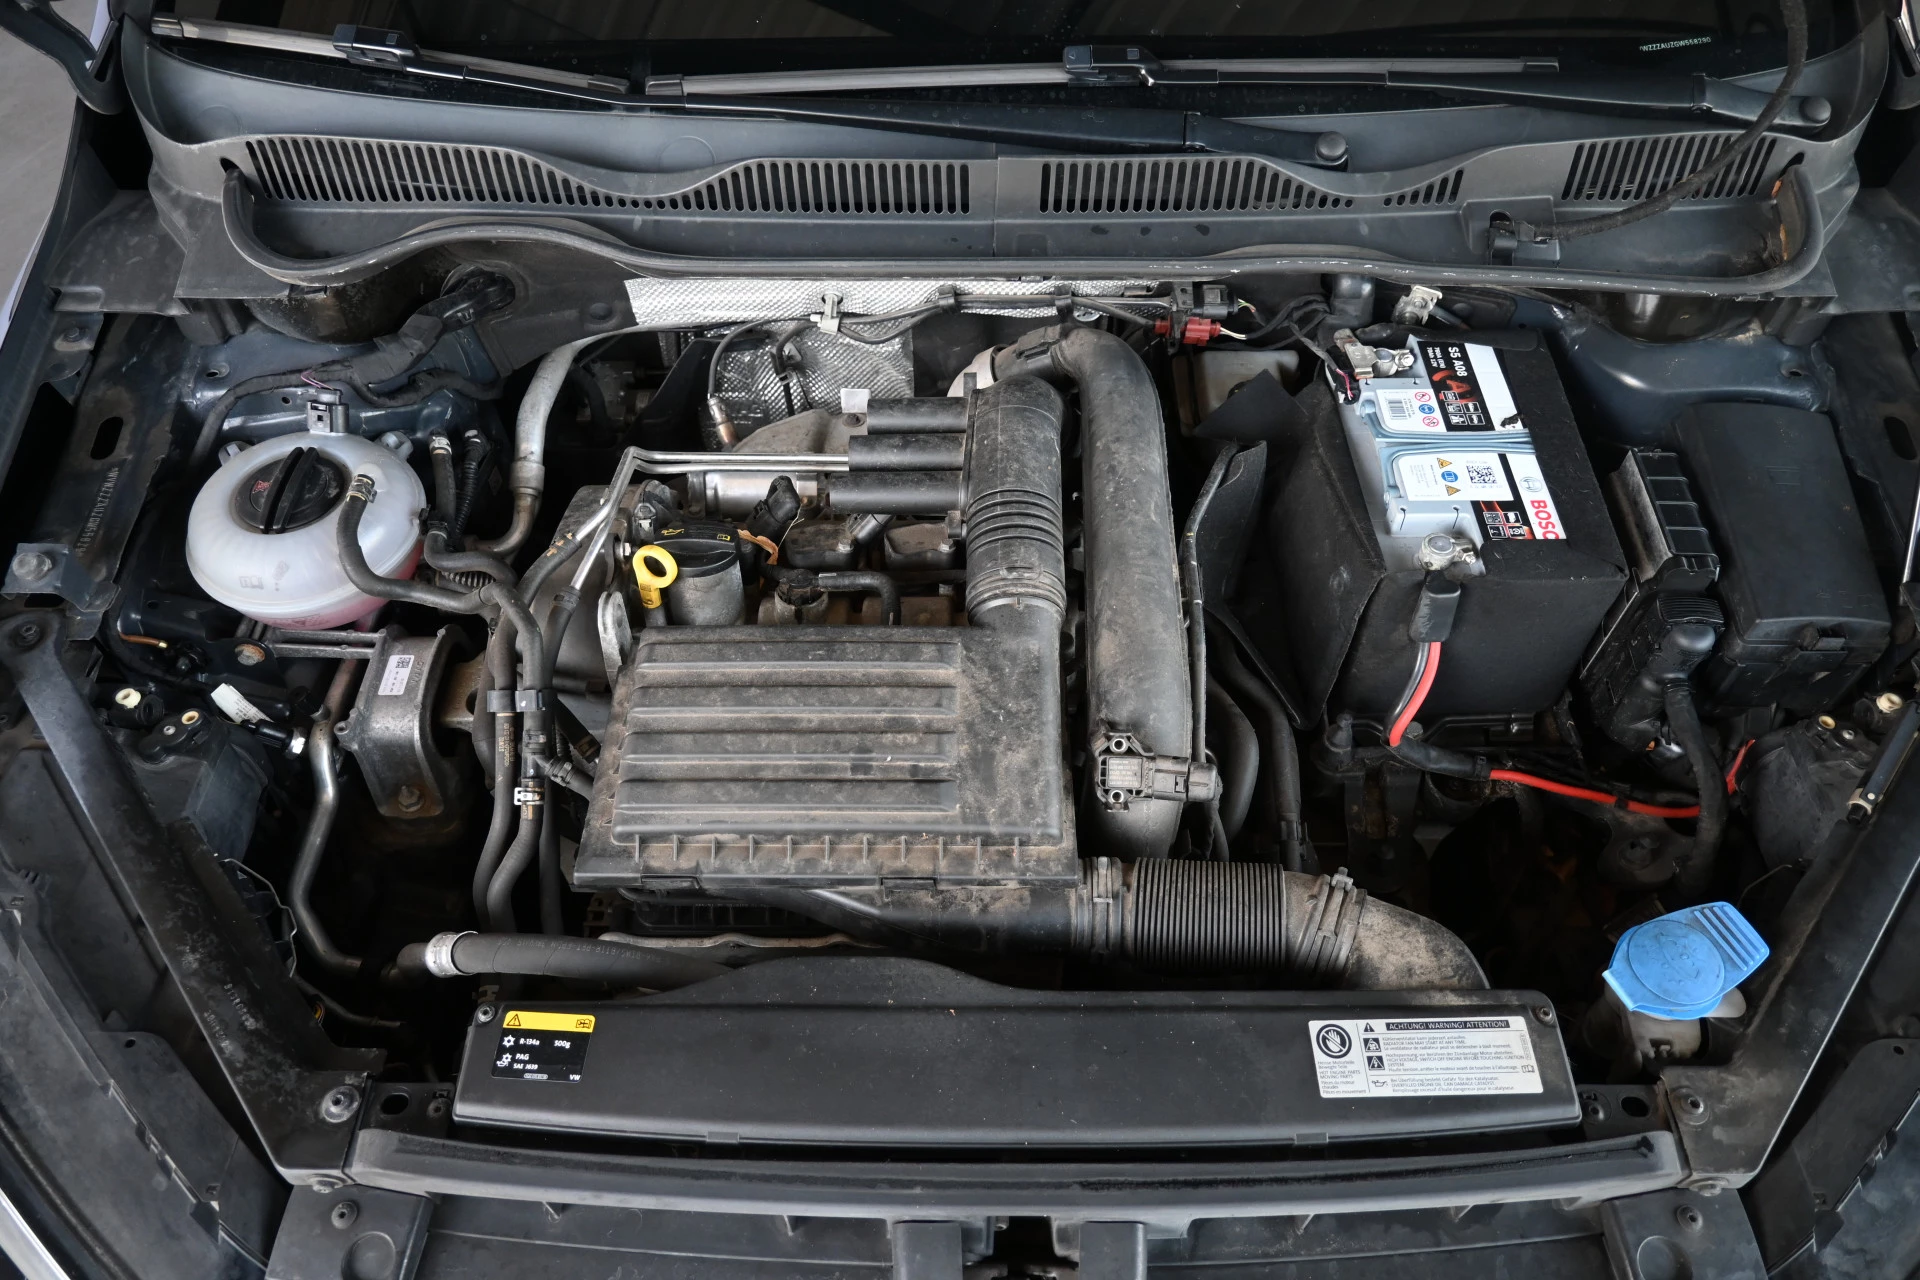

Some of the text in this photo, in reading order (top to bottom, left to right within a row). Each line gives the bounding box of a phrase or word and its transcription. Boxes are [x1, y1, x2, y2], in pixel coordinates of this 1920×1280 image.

[1448, 347, 1468, 377] S5 A08
[1389, 1020, 1507, 1030] ACHTUNG! WARNING! ATTENTION!
[519, 1038, 571, 1049] R-134a 500g
[515, 1053, 530, 1061] PAG
